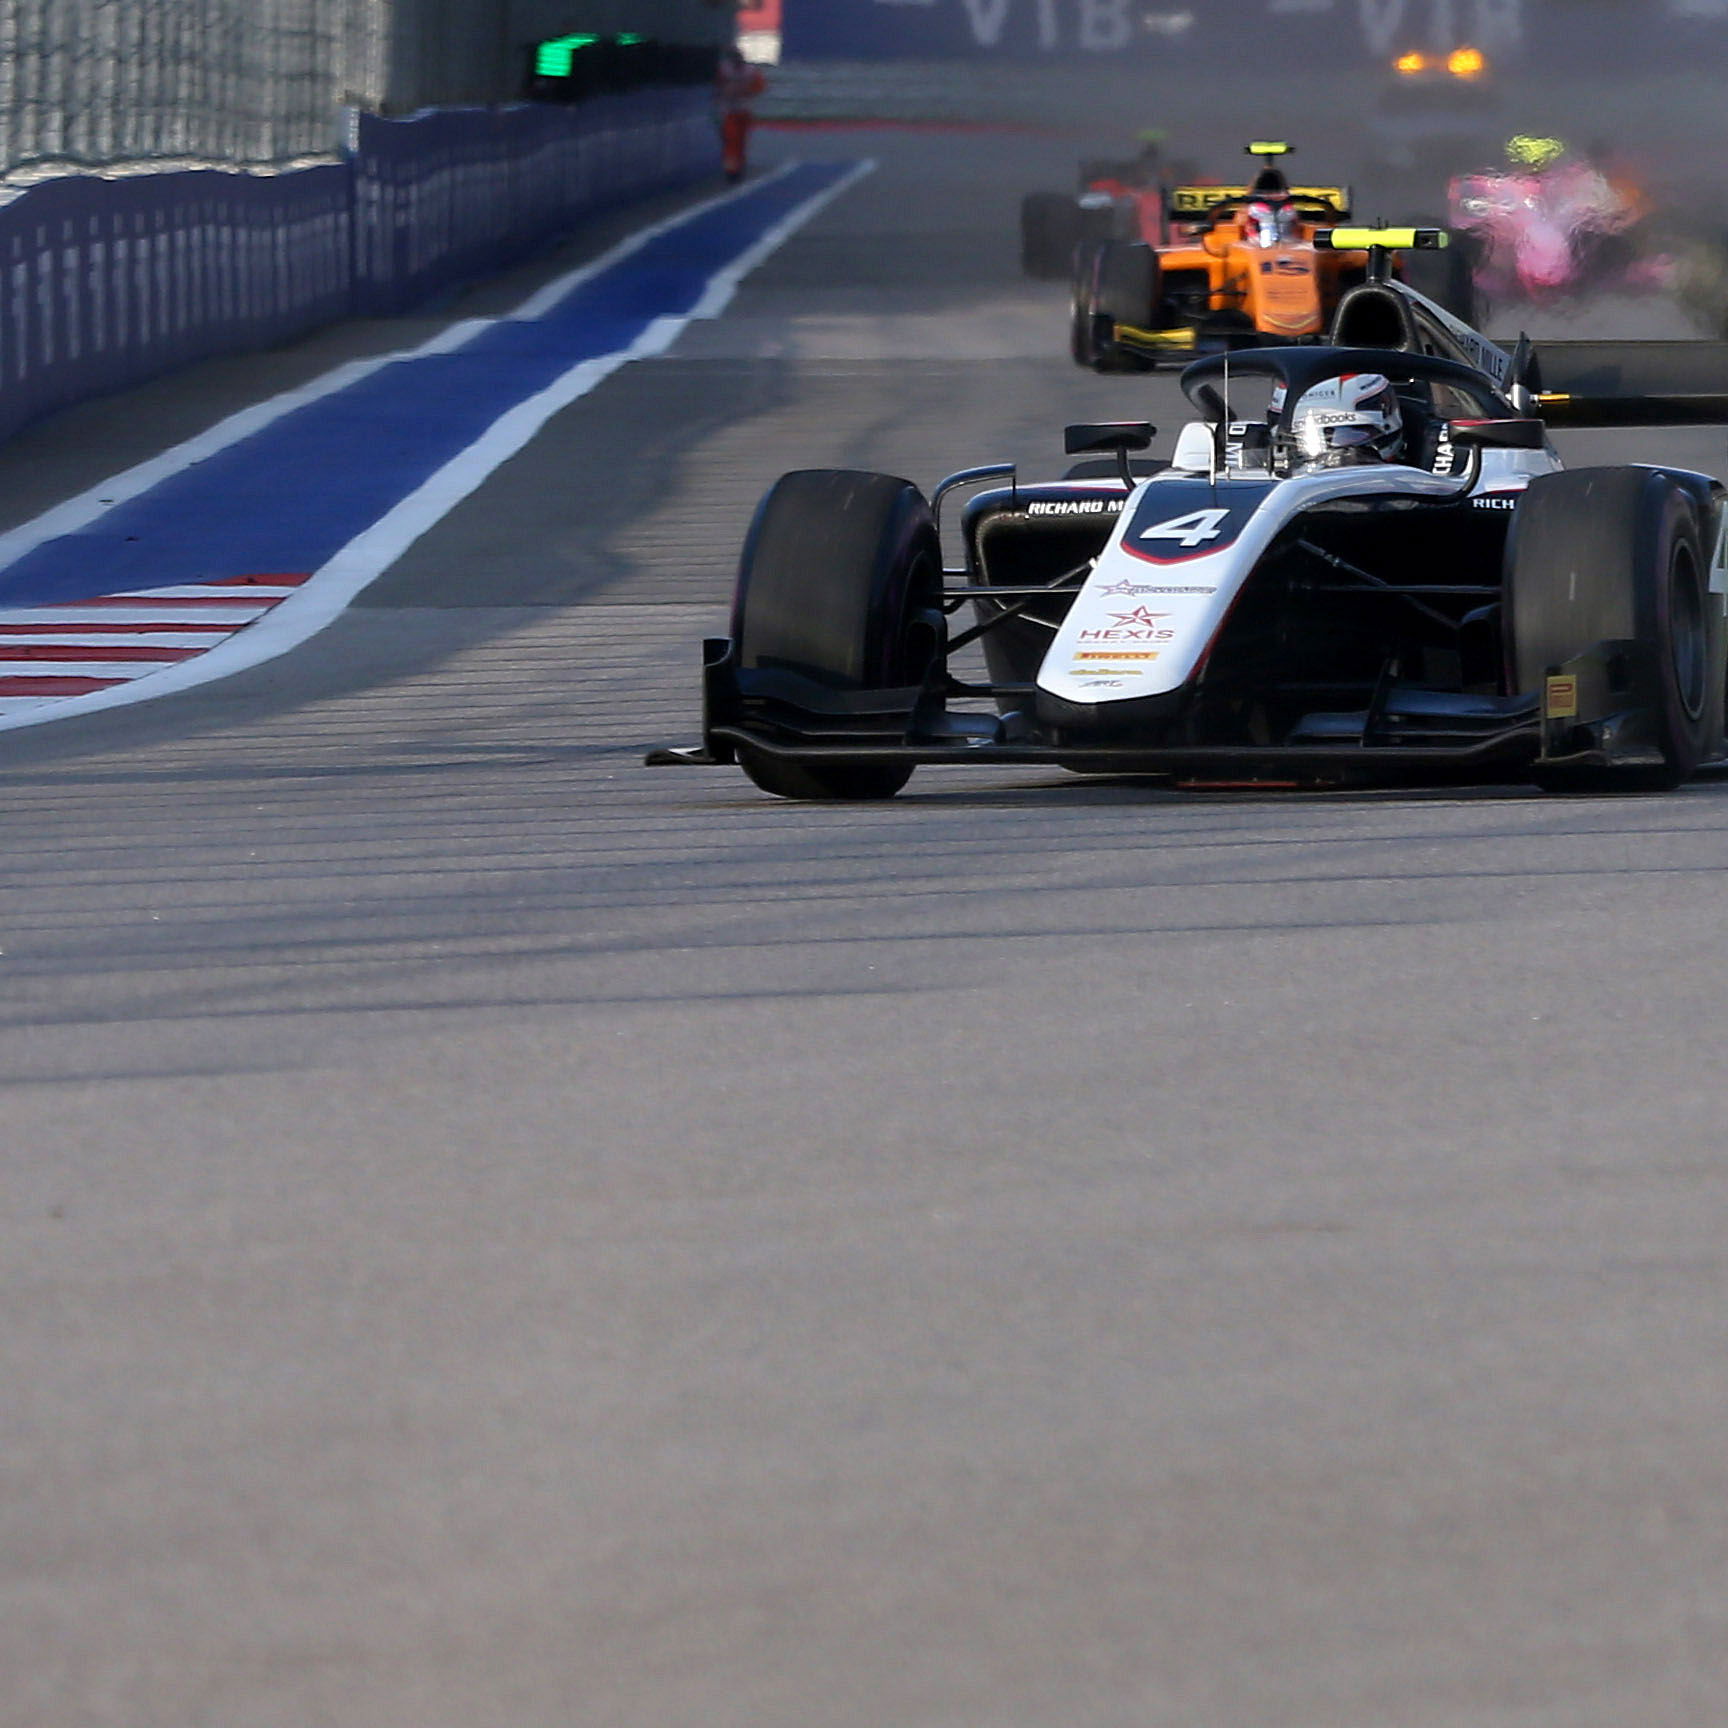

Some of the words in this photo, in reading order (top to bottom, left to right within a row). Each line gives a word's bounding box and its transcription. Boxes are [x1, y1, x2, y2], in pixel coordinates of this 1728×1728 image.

[1028, 501, 1103, 515] RICHARD
[1473, 498, 1515, 510] RICH
[1139, 508, 1231, 546] 4
[1079, 629, 1175, 640] HEXIS
